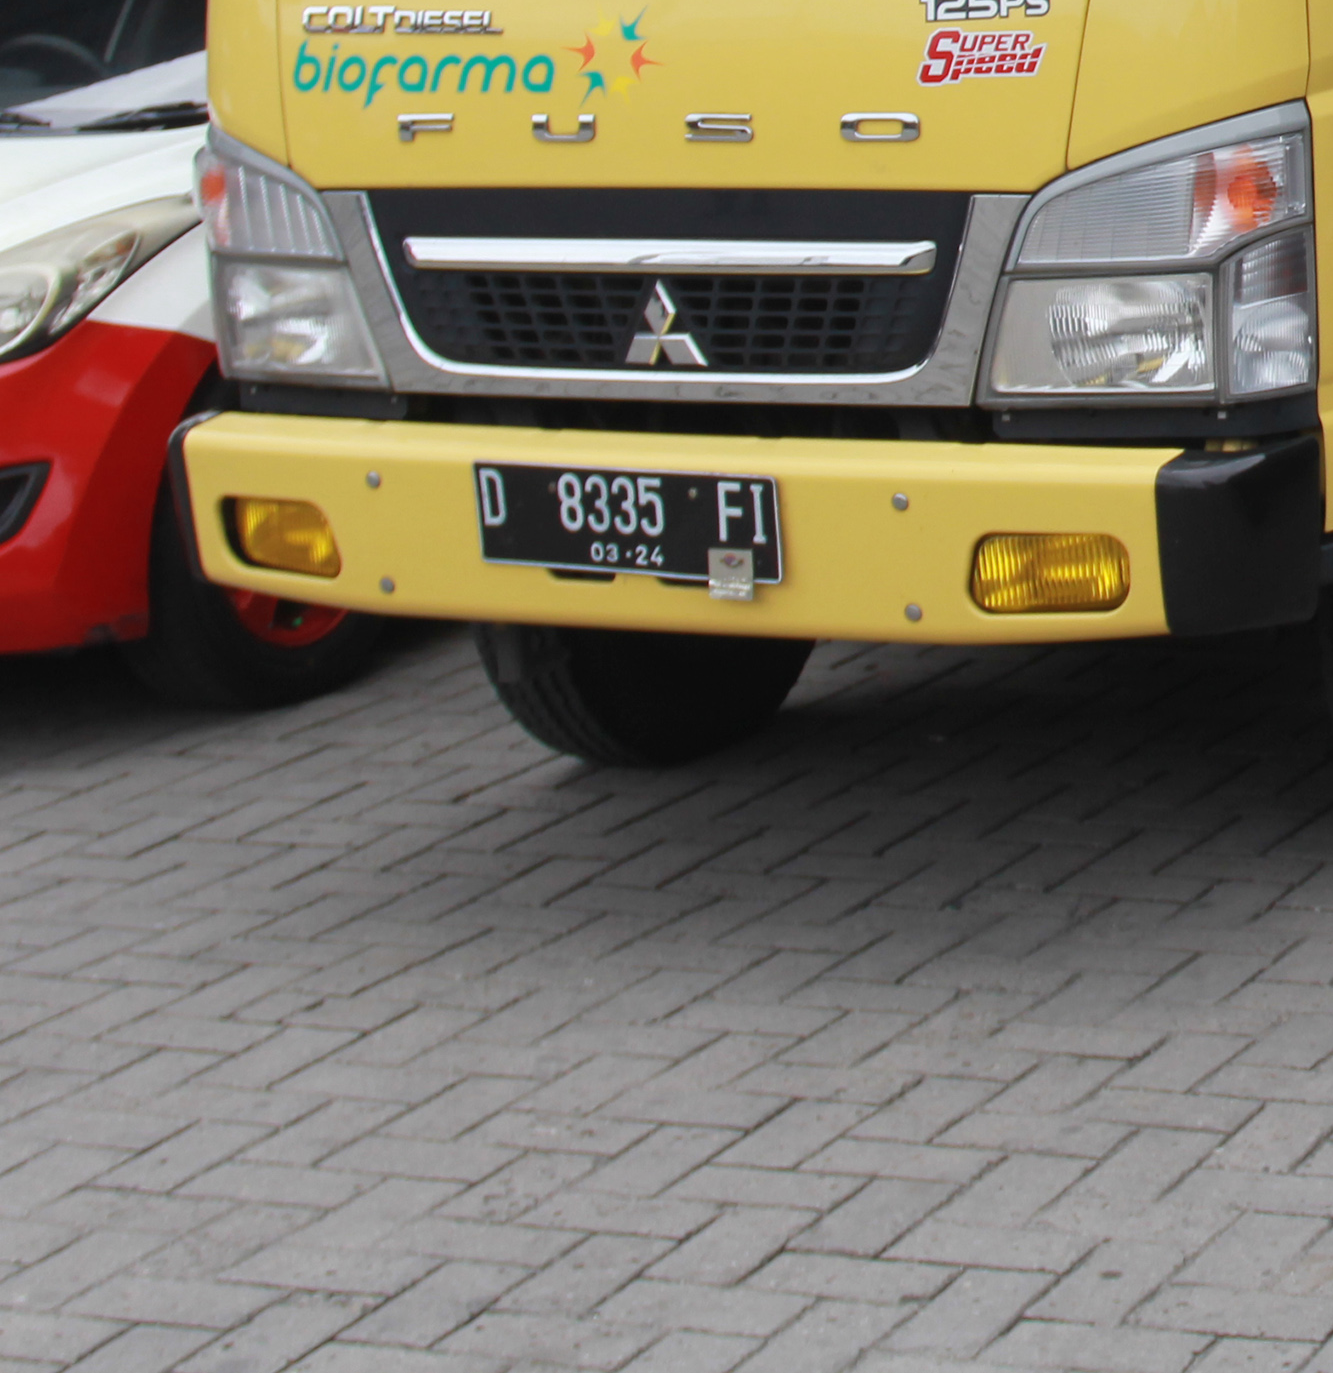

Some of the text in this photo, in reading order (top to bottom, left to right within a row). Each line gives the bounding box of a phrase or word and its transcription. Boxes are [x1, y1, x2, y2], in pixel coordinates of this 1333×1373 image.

[293, 38, 556, 110] biofarma
[397, 112, 921, 142] FUSO
[479, 468, 768, 544] D 8335 FI
